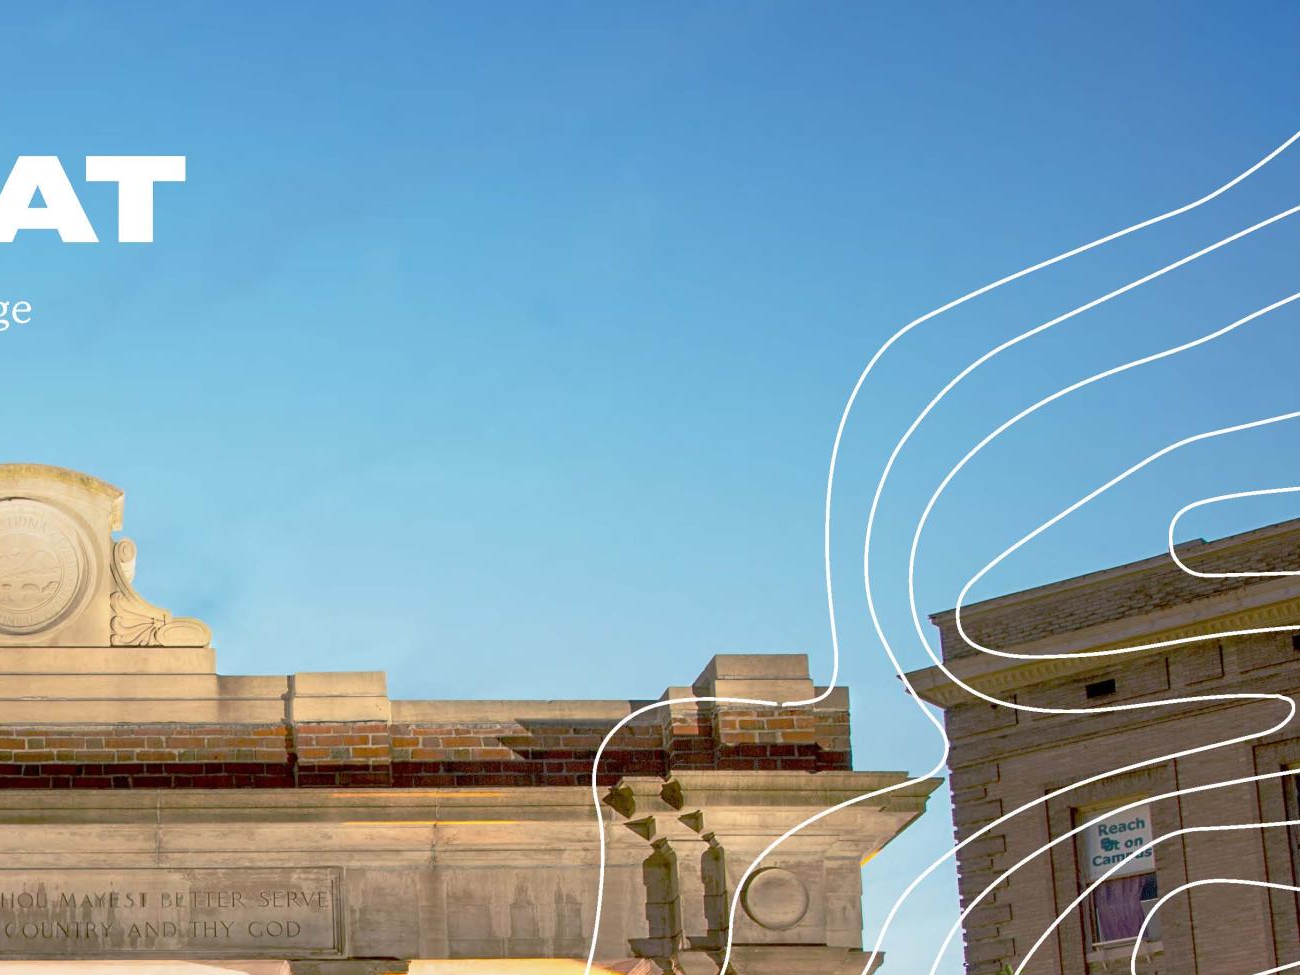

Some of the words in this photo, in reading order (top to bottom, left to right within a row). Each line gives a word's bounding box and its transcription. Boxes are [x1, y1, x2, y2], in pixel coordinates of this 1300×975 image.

[1097, 817, 1146, 837] Reach
[1124, 837, 1144, 849] on
[1092, 847, 1153, 867] Camus
[60, 891, 149, 909] MAYEST
[161, 891, 246, 909] BETTER
[258, 891, 330, 908] SERVE
[4, 920, 114, 940] COUNTRY
[127, 920, 178, 938] AND
[188, 920, 236, 939] THY
[247, 920, 301, 938] GOD
